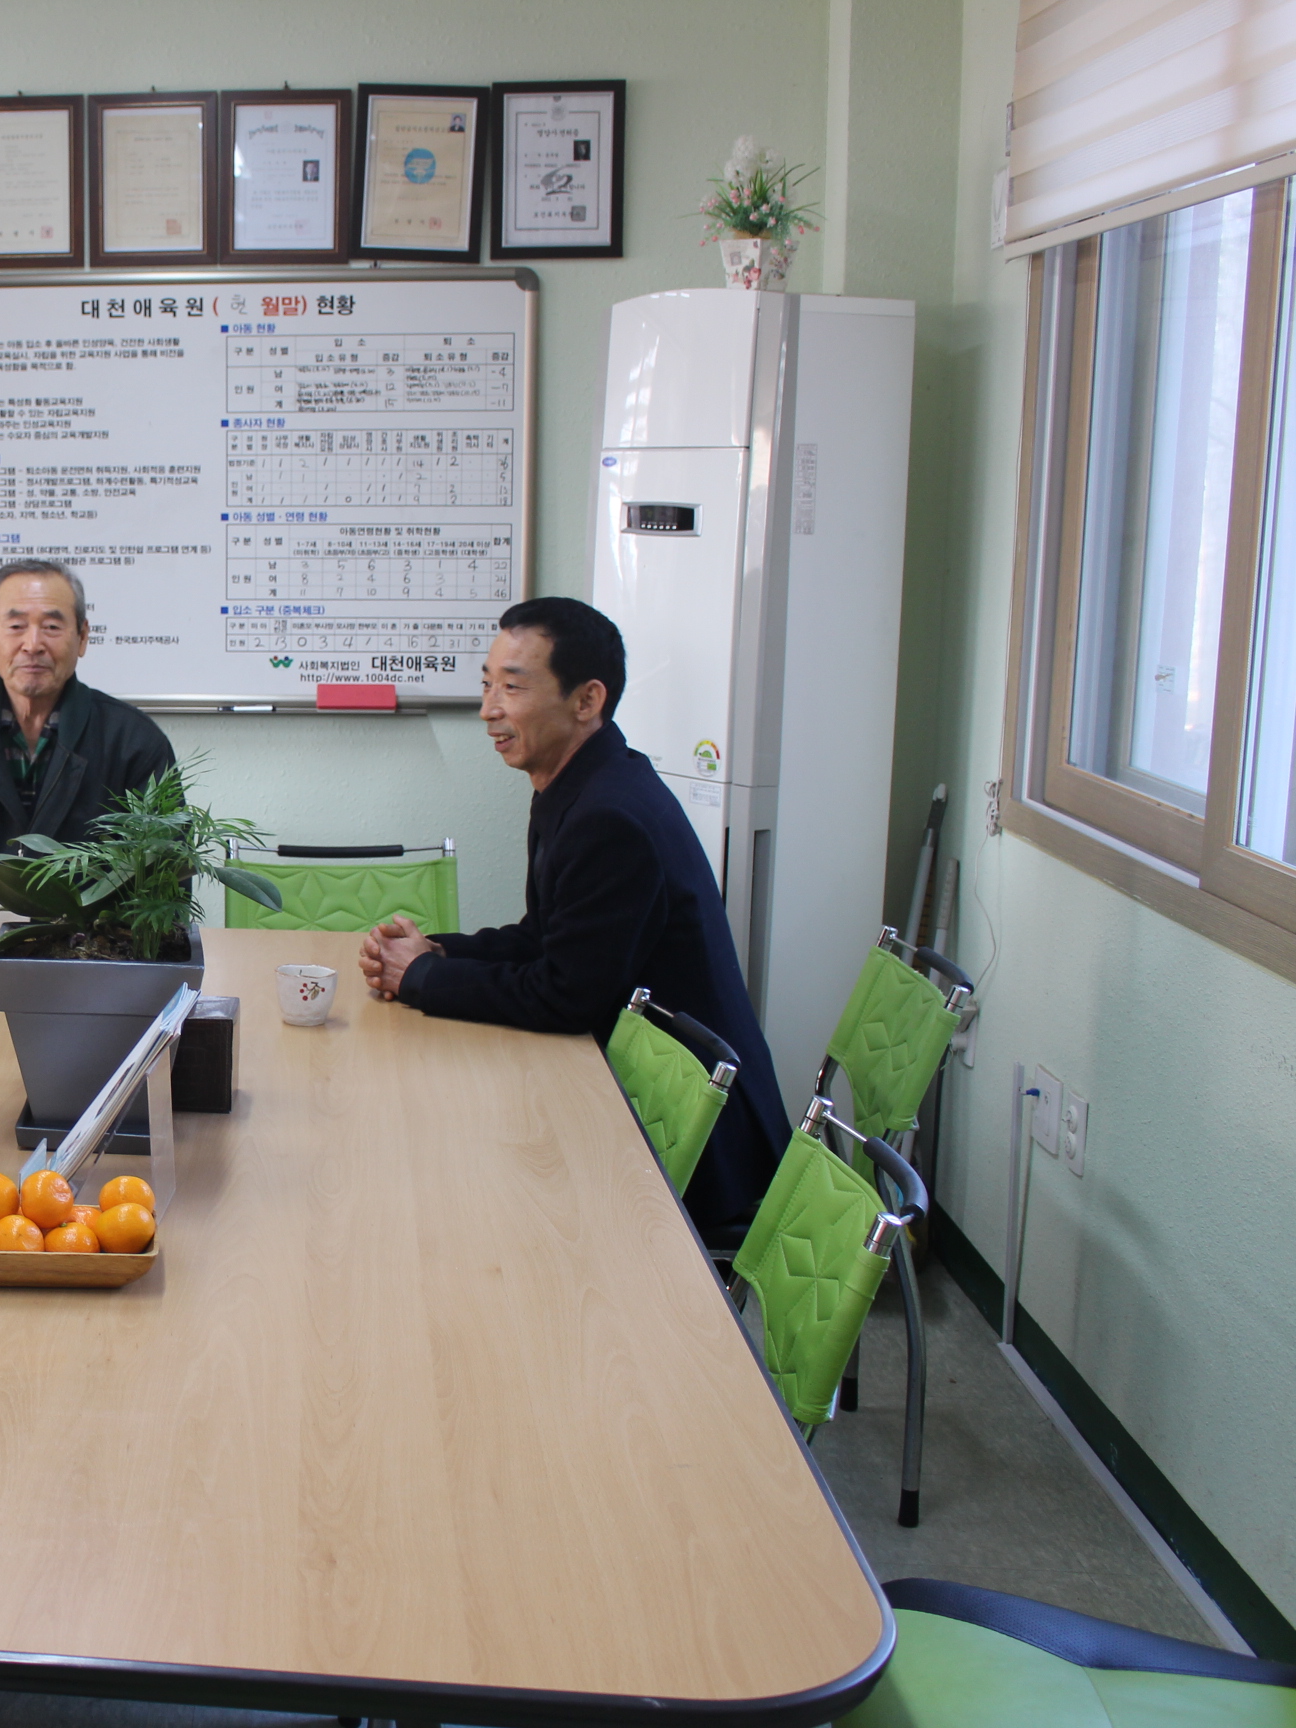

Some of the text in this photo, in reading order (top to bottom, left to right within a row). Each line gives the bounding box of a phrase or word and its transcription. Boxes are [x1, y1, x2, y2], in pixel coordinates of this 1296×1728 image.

[316, 294, 356, 316] 현황
[233, 324, 276, 333] 아동 현황
[233, 418, 286, 428] 종사자 현황
[233, 512, 252, 522] 아동
[257, 512, 275, 522] 성별
[309, 512, 328, 521] 현황
[494, 589, 507, 598] 46
[233, 606, 252, 614] 입소
[255, 606, 275, 615] 구분
[299, 656, 456, 672] 사회복지법인 대천애육원
[300, 674, 424, 682] http://www.1004dc.net
